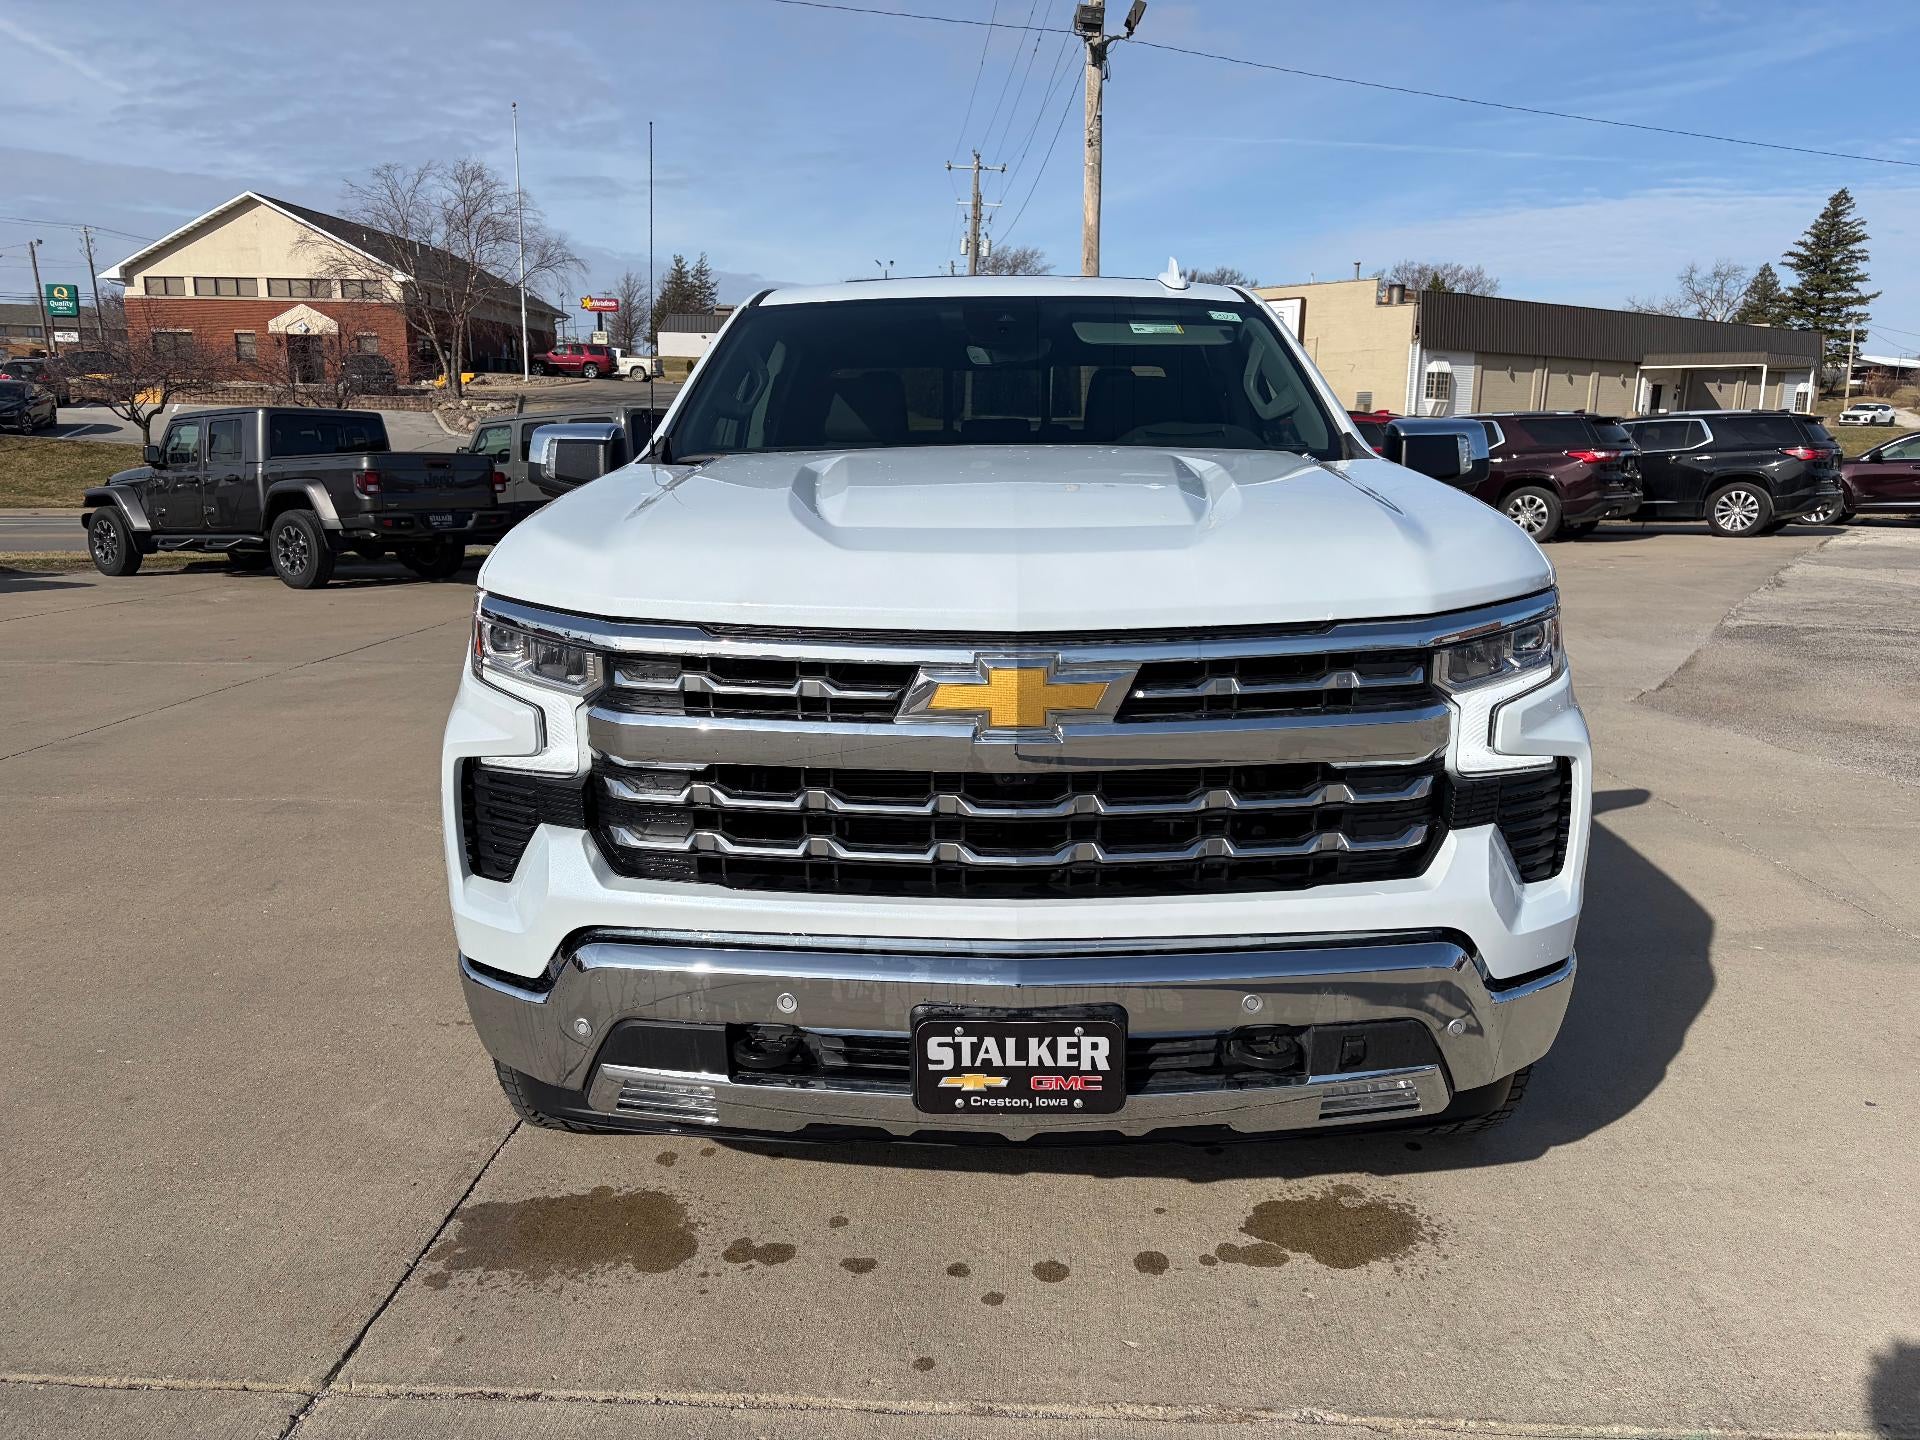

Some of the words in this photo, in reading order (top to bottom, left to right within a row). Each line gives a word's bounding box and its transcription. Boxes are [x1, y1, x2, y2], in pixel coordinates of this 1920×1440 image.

[49, 300, 73, 308] Quality
[927, 1036, 1110, 1071] STALKER
[1031, 1075, 1103, 1091] GMC
[970, 1096, 1033, 1109] Creston,
[1035, 1097, 1068, 1107] Iowa
